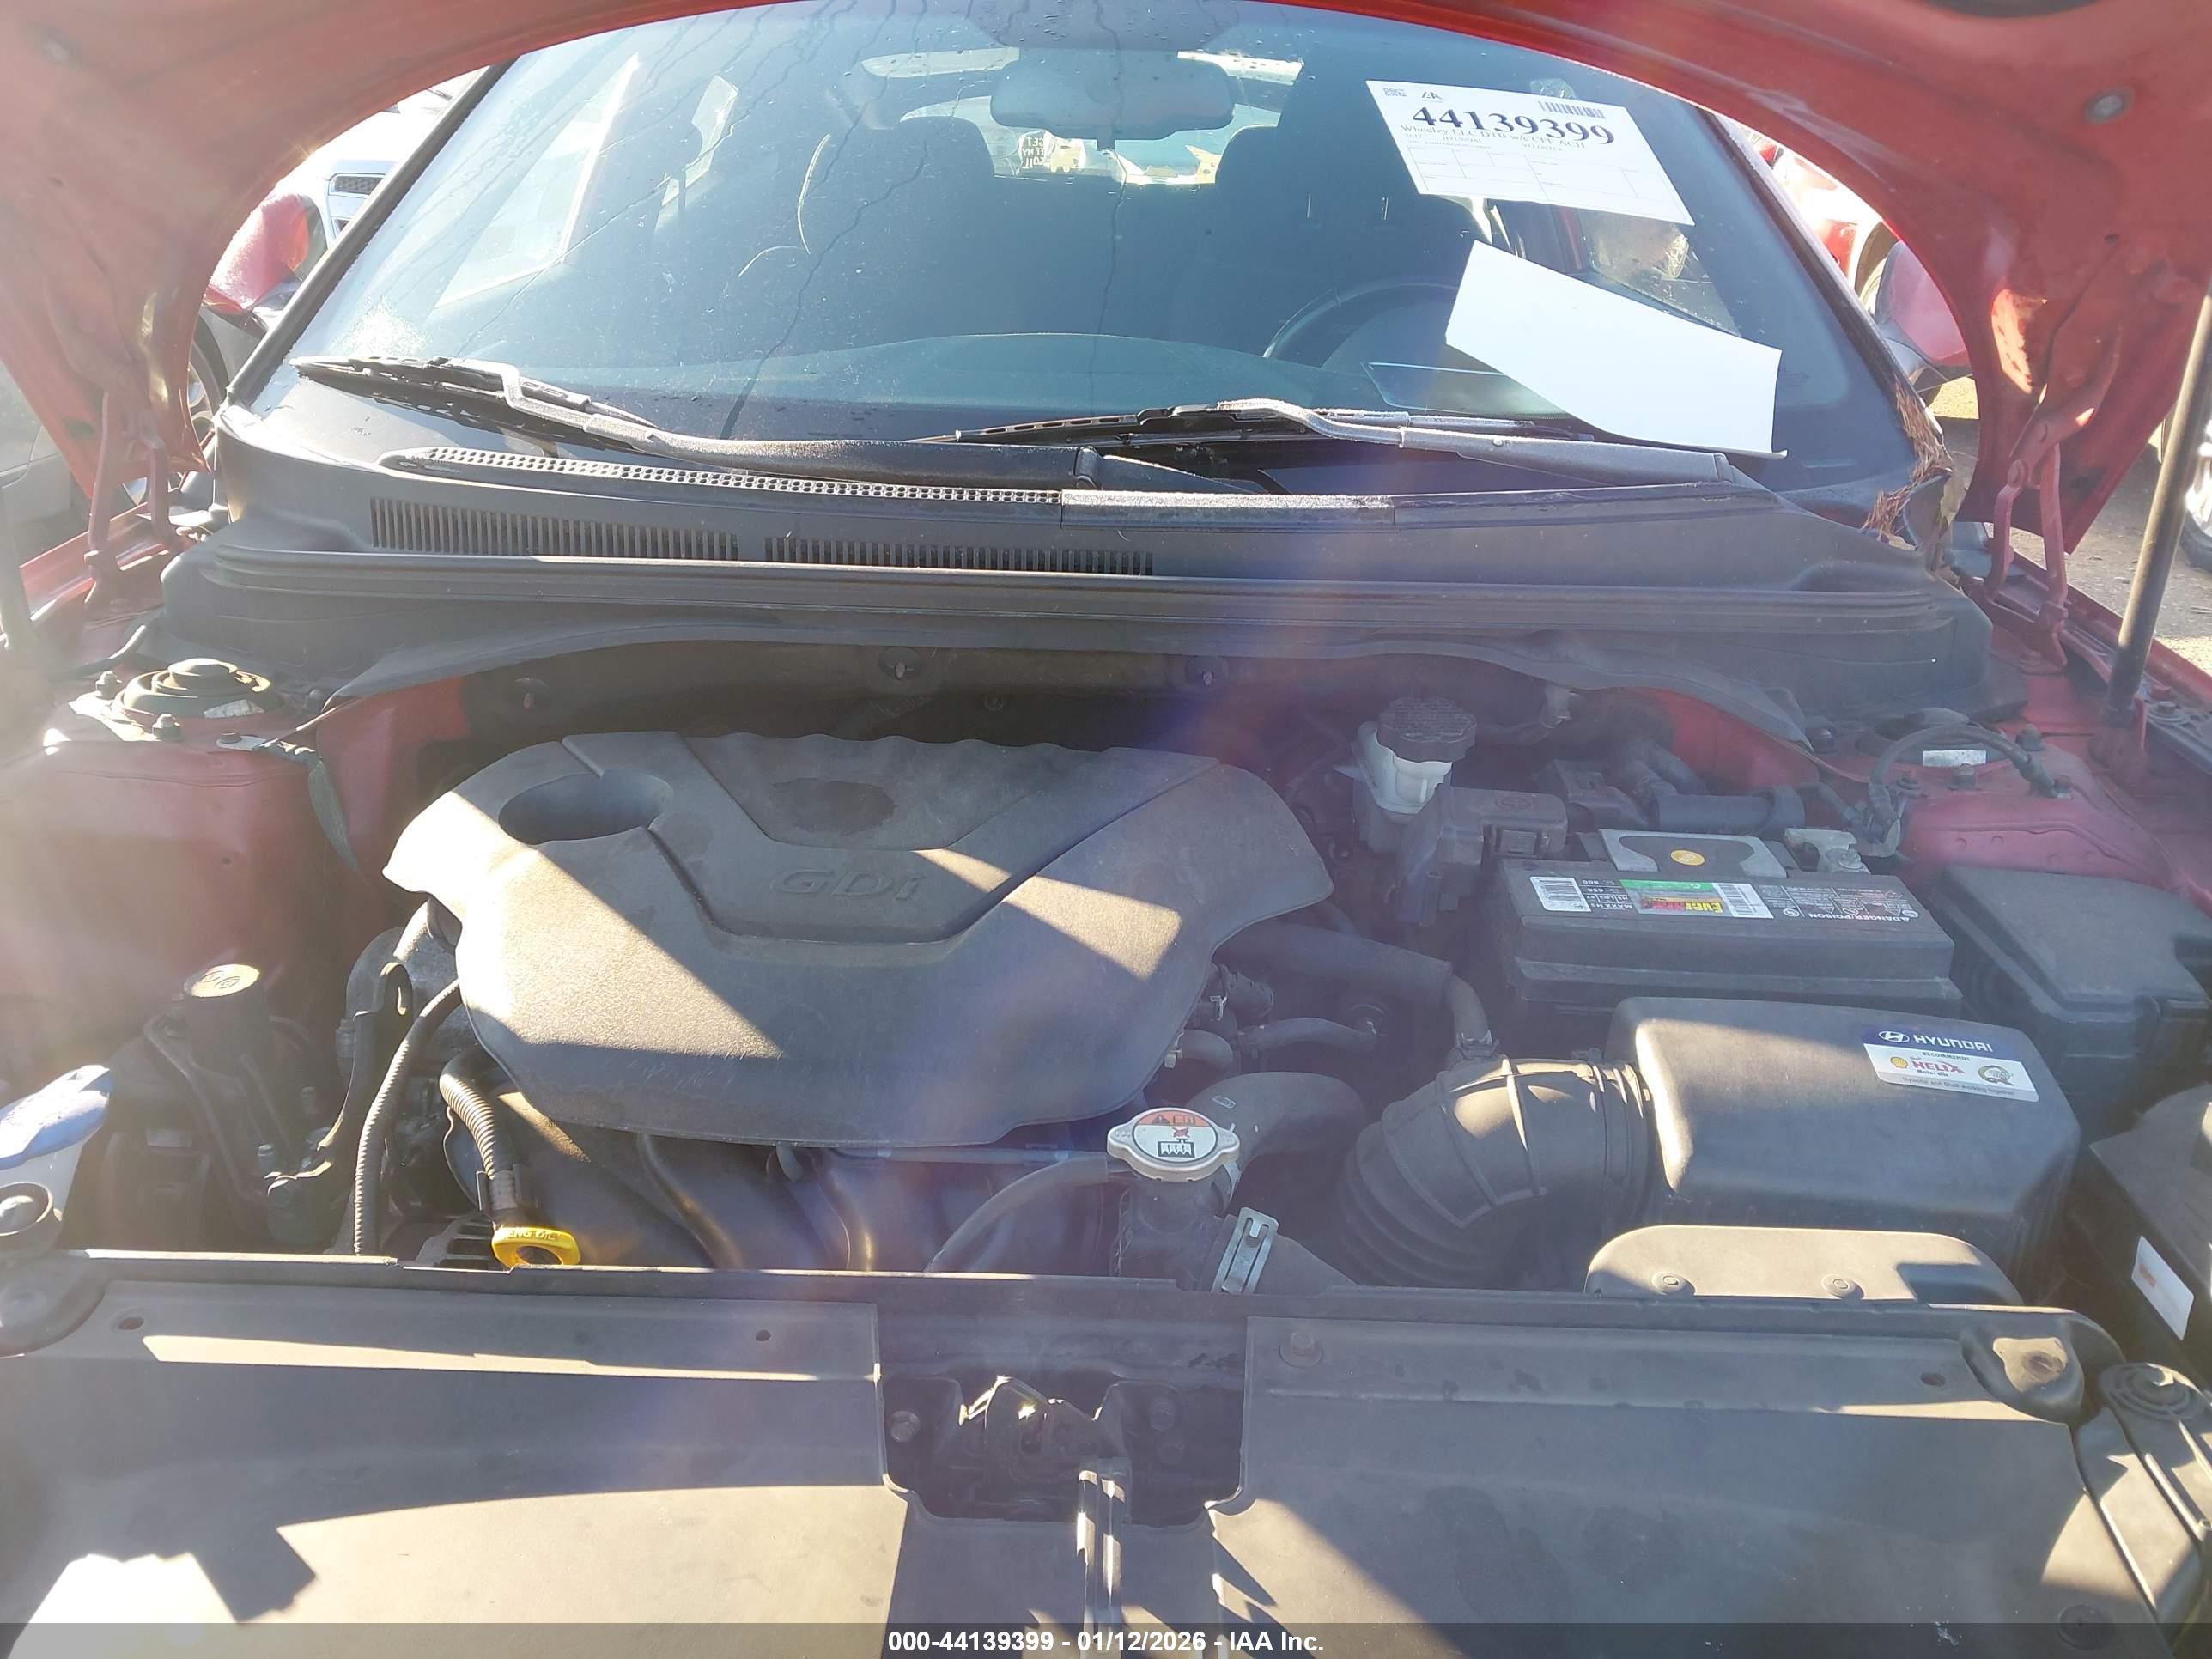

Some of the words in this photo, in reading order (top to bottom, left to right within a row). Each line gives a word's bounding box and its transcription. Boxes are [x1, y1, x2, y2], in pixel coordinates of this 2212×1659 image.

[1413, 106, 1615, 145] 44139399
[1809, 913, 1905, 922] DANGER/POISON
[1913, 1034, 1993, 1053] HYUNDAI
[1911, 1060, 1966, 1074] HELIX
